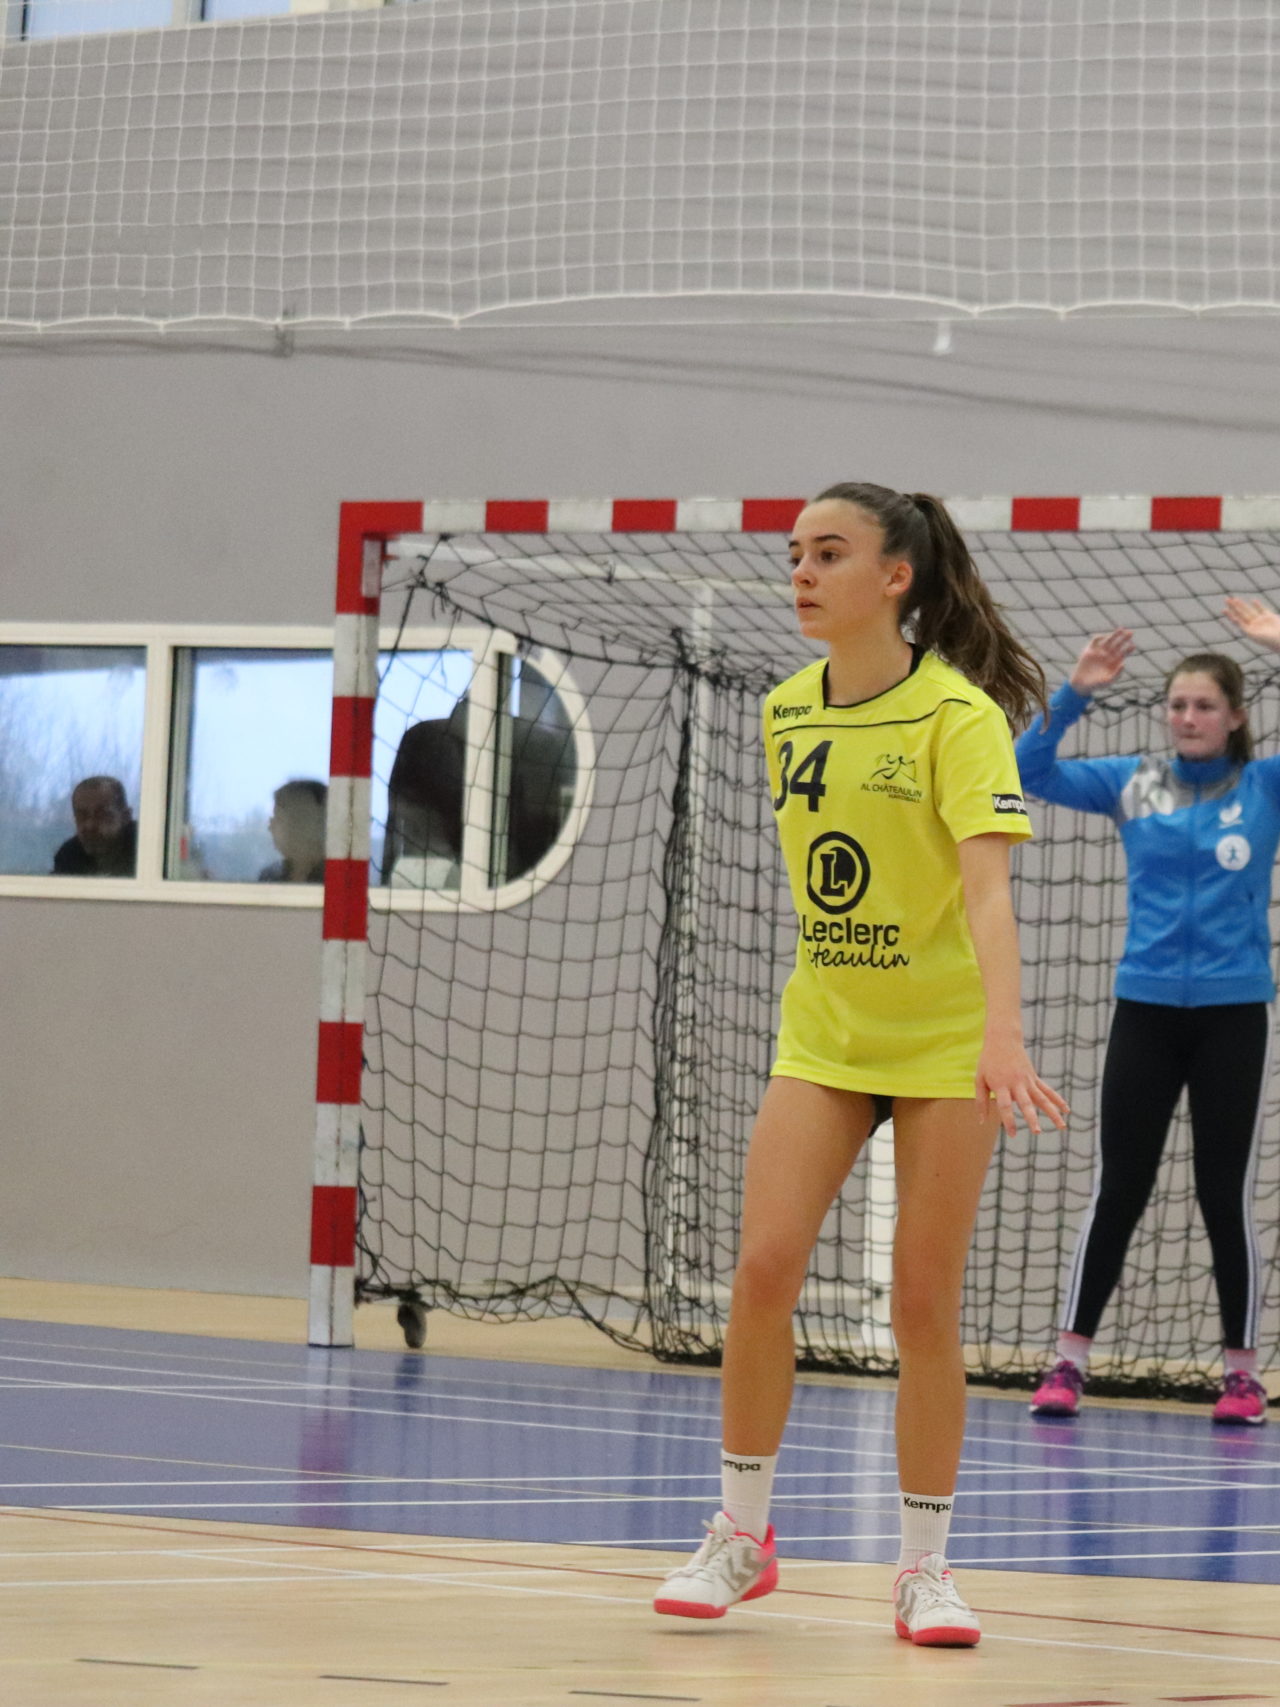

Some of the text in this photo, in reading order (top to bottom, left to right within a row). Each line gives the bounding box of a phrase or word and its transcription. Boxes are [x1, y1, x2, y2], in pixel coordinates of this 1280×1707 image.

[774, 740, 833, 813] 34
[993, 796, 1025, 813] Kemp
[802, 914, 900, 947] Leclerc
[807, 943, 910, 970] teaulin
